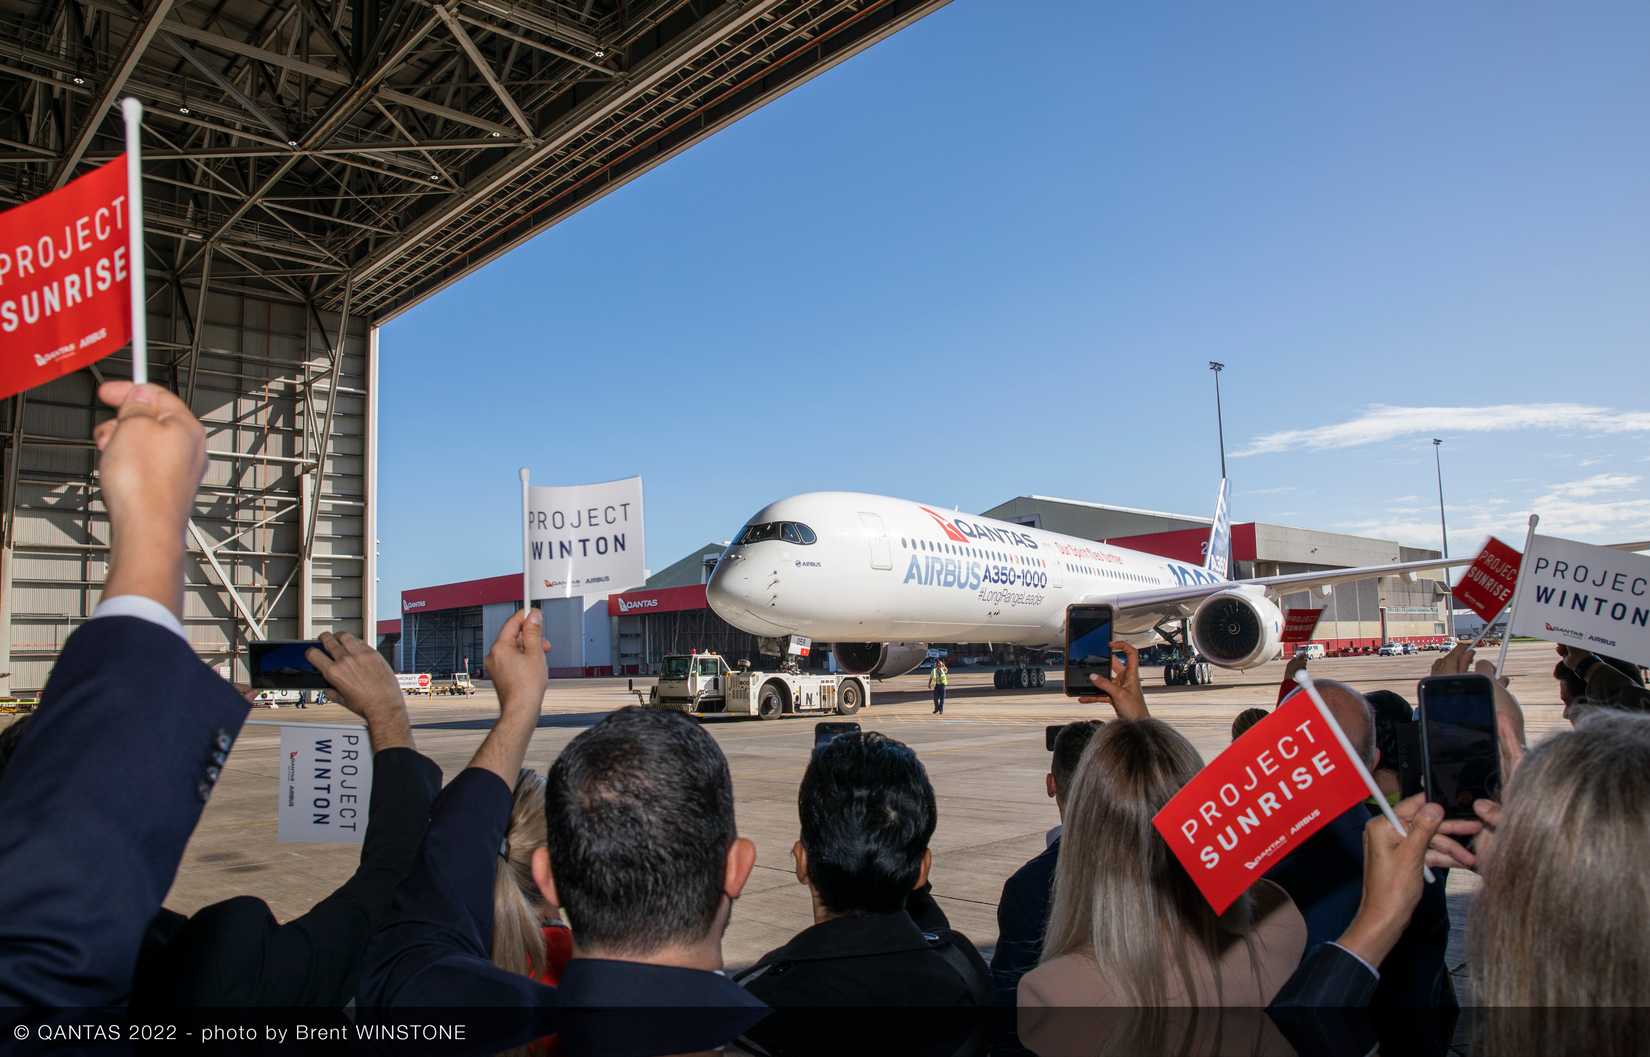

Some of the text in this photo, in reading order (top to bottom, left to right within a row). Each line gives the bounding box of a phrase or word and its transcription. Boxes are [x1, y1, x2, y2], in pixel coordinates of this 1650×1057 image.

[0, 195, 125, 285] PROJECT
[1, 246, 127, 333] SUNRISE
[529, 502, 631, 531] PROJECT
[954, 518, 1039, 550] QANTAS
[531, 533, 626, 561] WINTON
[1480, 549, 1518, 581] PROJEC
[903, 554, 1048, 591] AIRBUS A350-1000
[1467, 566, 1511, 601] SUNRISE
[1534, 557, 1648, 596] PROJEC
[626, 599, 658, 609] QANTAS
[1536, 585, 1650, 627] WINTON
[313, 739, 333, 825] WINTON
[339, 735, 359, 832] PROJECT
[1181, 720, 1316, 844] PROJECT
[1199, 751, 1336, 869] SUNRISE
